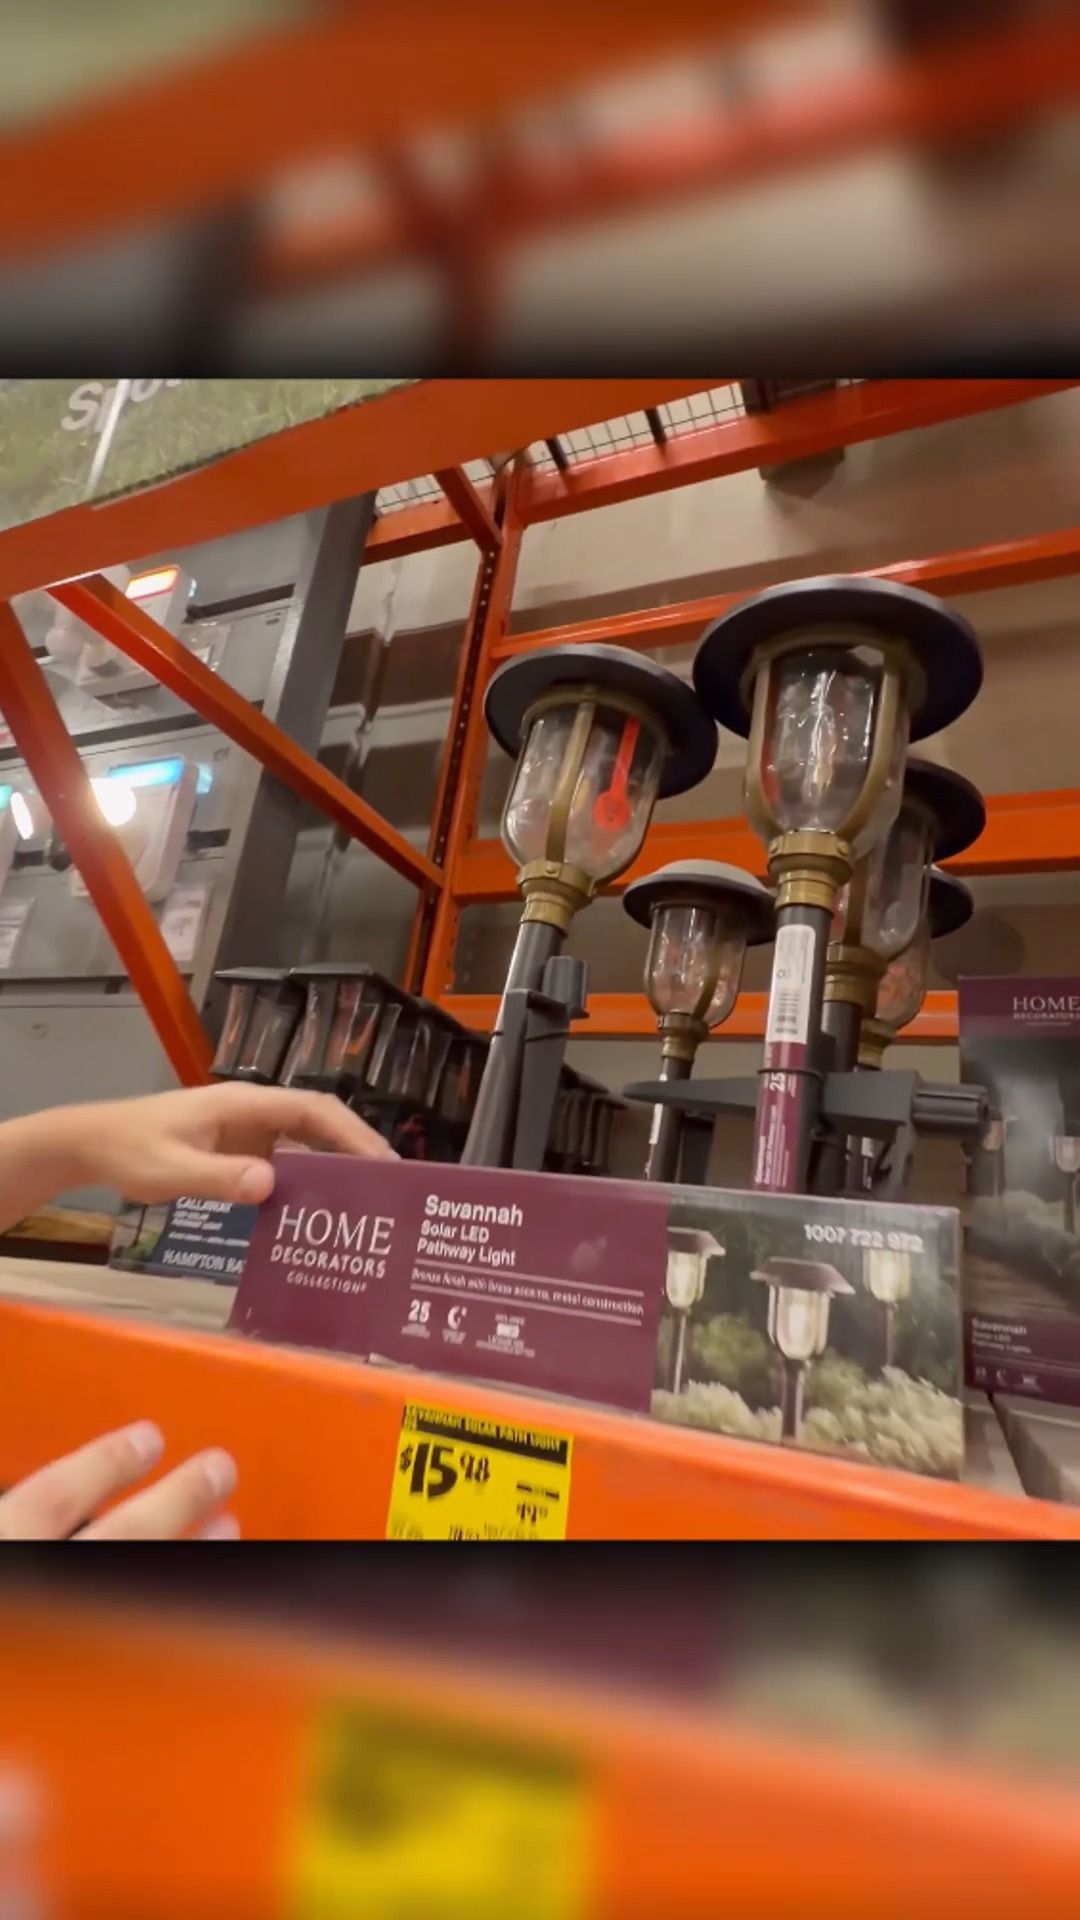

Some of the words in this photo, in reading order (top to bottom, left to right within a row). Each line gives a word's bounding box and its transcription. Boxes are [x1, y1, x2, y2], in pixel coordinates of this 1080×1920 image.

[1013, 996, 1080, 1011] HOME
[425, 1194, 523, 1227] Savannah
[275, 1205, 395, 1255] HOME
[421, 1219, 457, 1240] Solar
[460, 1224, 489, 1244] LED
[804, 1224, 847, 1244] 1007
[162, 1249, 224, 1271] HAMPTON
[271, 1244, 386, 1279] DECORATORS
[417, 1237, 476, 1263] Pathway
[478, 1246, 516, 1267] Light
[408, 1299, 431, 1323] 25
